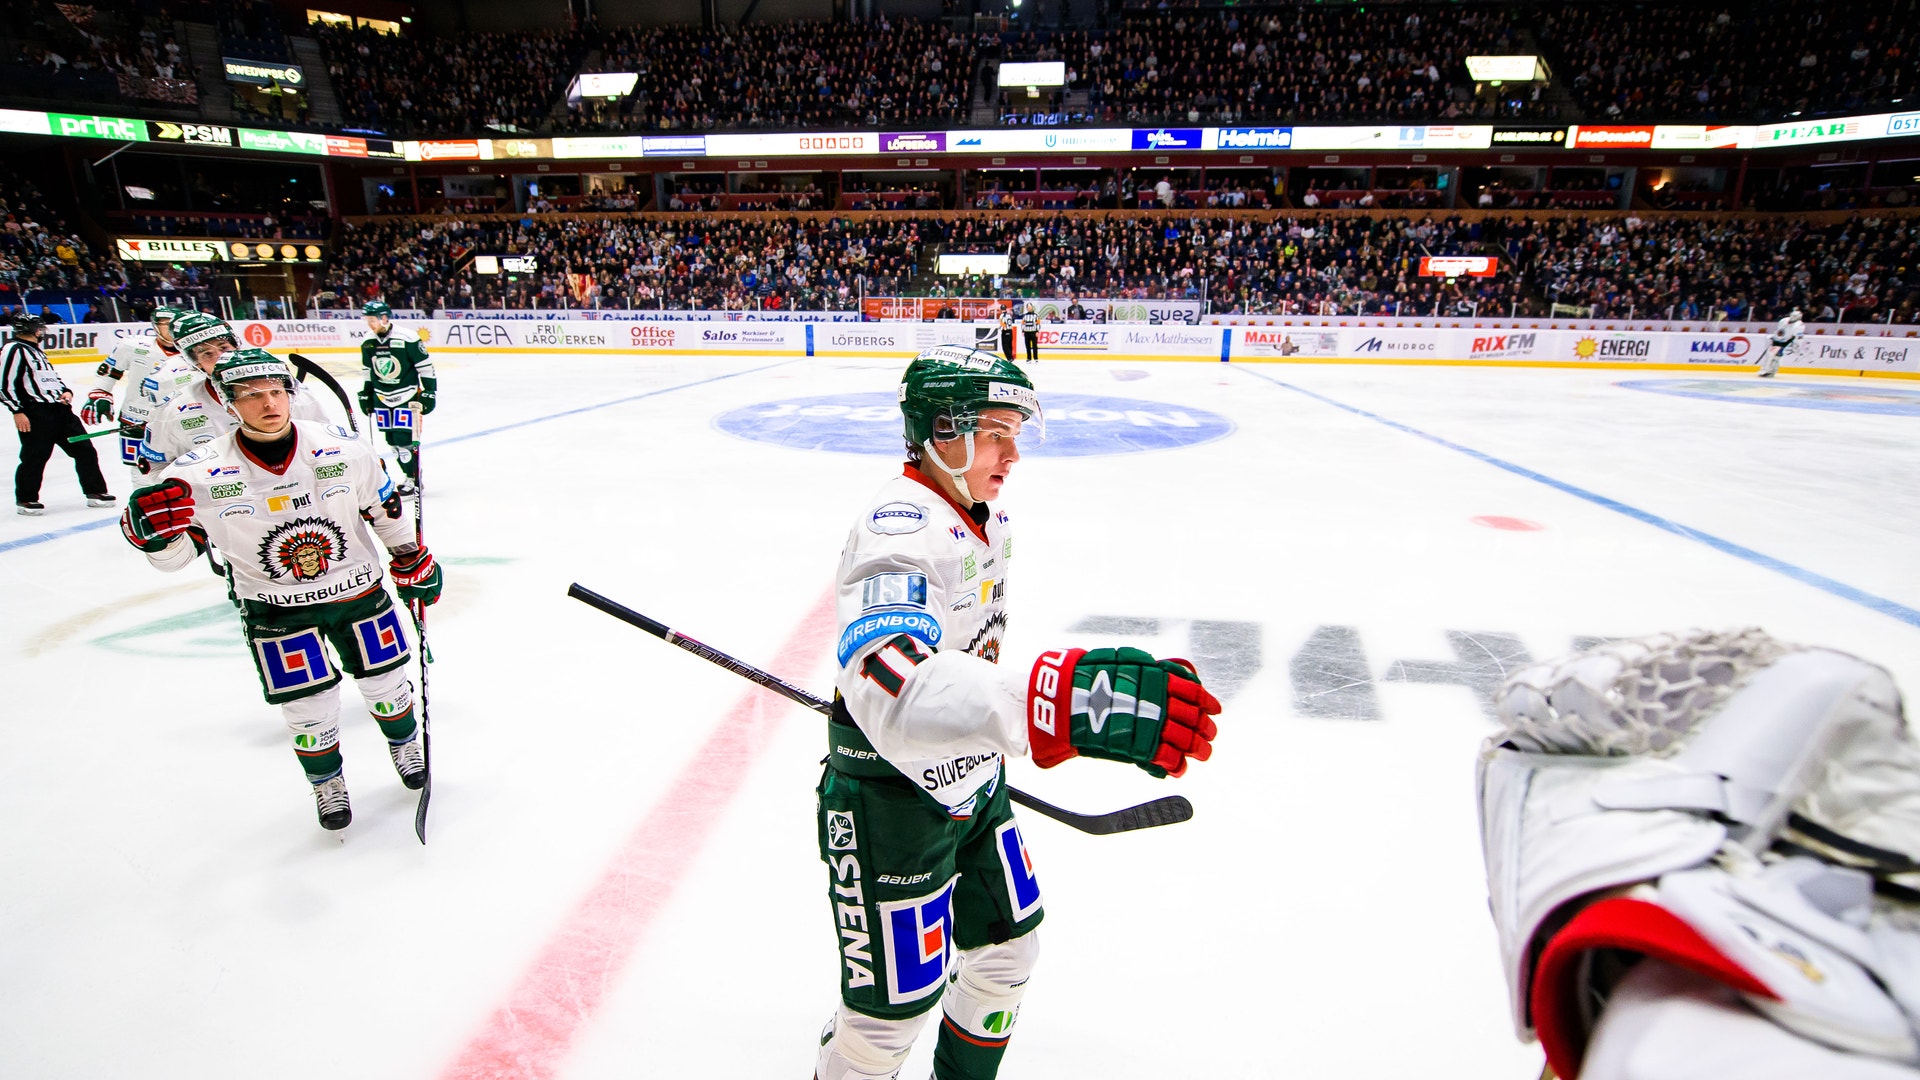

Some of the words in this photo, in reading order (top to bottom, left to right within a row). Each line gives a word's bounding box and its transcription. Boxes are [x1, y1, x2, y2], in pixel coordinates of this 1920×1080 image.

[226, 63, 286, 80] SWEDWISE
[60, 115, 136, 137] print
[1773, 123, 1846, 141] PEAB
[182, 124, 232, 143] PSM
[1218, 130, 1291, 147] Helmia
[148, 242, 217, 252] BILLES
[276, 323, 336, 333] AllOffice
[630, 327, 675, 338] Office
[446, 324, 513, 346] ATEA
[525, 332, 606, 345] LÄROVERKEN
[702, 330, 738, 342] Salos
[832, 334, 896, 347] LÖFBERGS
[1060, 331, 1108, 342] FRAKT
[1125, 332, 1150, 345] Max
[1152, 332, 1213, 345] Matthiessen
[1245, 331, 1281, 343] MAXI
[632, 338, 675, 347] DEPOT
[1386, 343, 1434, 351] MIDROC
[1600, 339, 1651, 357] ENERGI
[1691, 341, 1736, 353] KMAB
[1820, 345, 1848, 358] Puts
[1854, 347, 1865, 359] &
[1874, 347, 1908, 364] Tegel
[316, 464, 339, 475] CASH
[317, 470, 344, 480] BUDDY
[211, 483, 236, 494] CASH
[213, 489, 243, 500] BUDDY
[224, 507, 251, 517] BOHUS
[876, 511, 921, 519] VOLVO
[349, 563, 372, 578] FILM
[257, 571, 373, 605] SILVERBULLET
[840, 615, 938, 655] EHRENBORG
[676, 637, 769, 686] BAUER
[860, 634, 930, 698] 11
[837, 745, 878, 761] BAUER
[876, 872, 933, 890] BAUER
[830, 853, 876, 989] STENA
